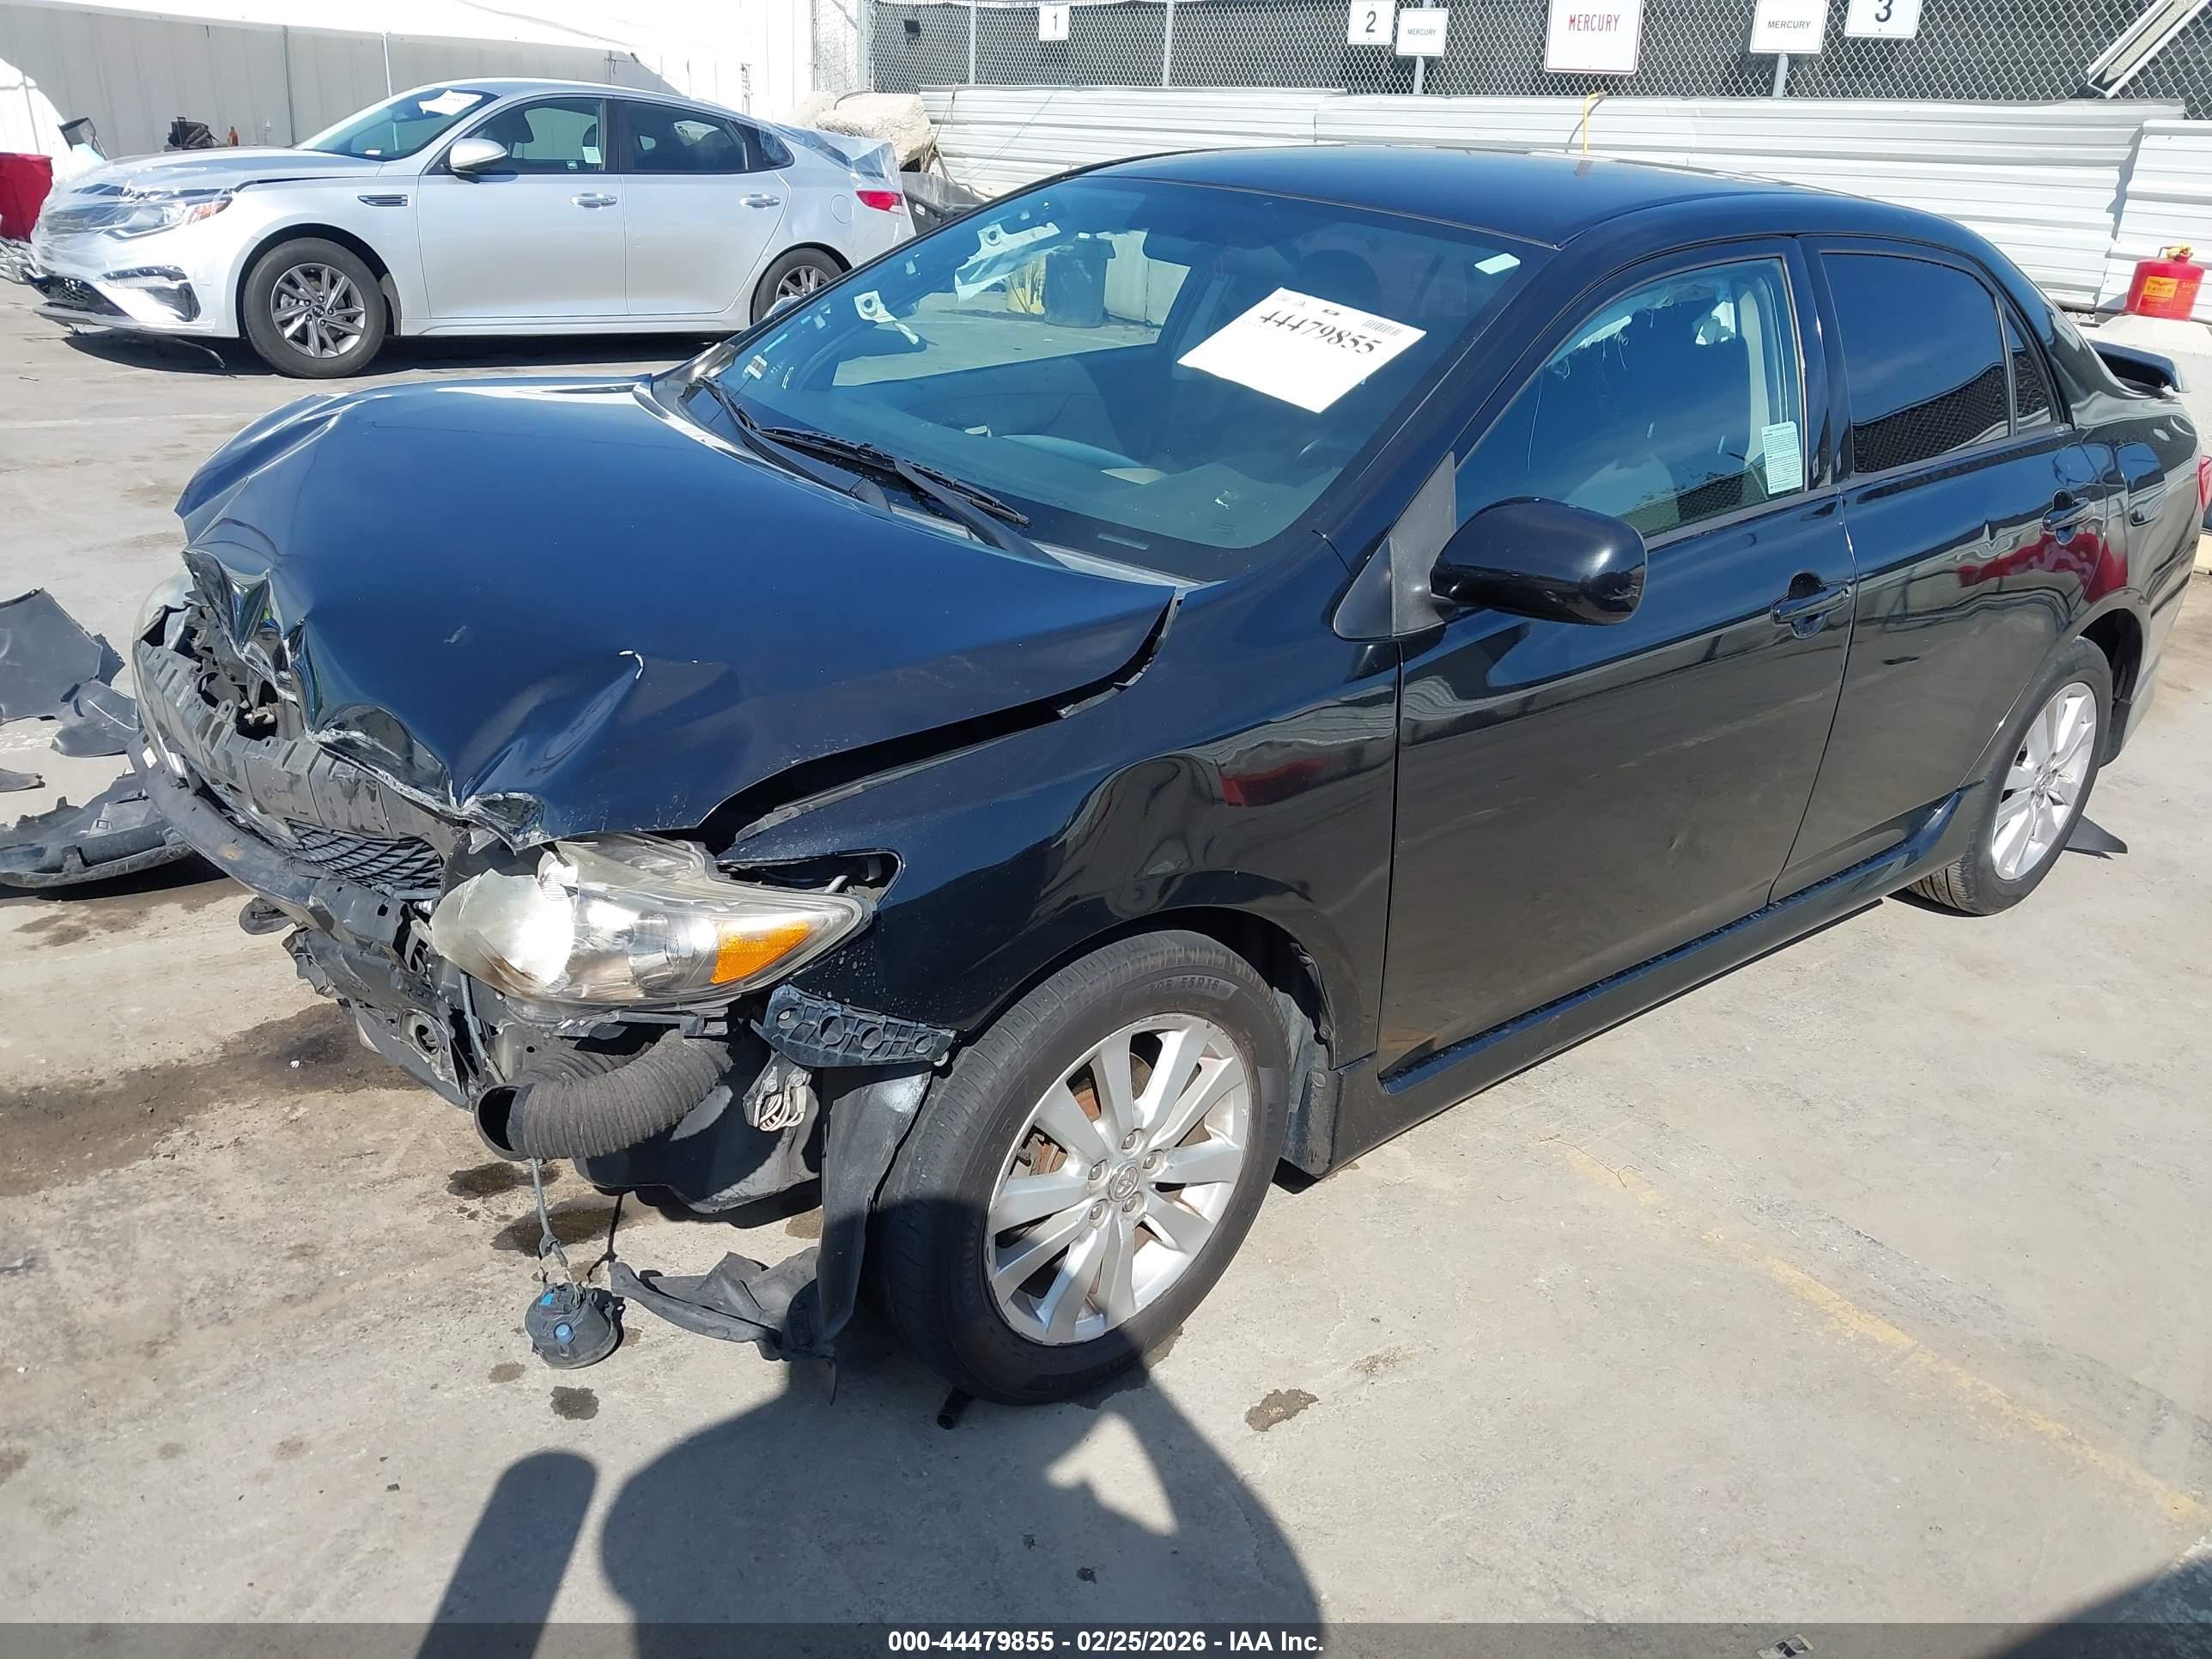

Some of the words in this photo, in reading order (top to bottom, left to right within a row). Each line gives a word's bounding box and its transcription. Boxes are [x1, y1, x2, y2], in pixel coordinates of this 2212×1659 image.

[1875, 0, 1893, 22] 3
[1053, 13, 1057, 32] 1
[1365, 10, 1376, 33] 2
[1568, 14, 1620, 32] MERCURY
[1767, 21, 1811, 29] MERCURY
[1259, 310, 1383, 354] 44479855
